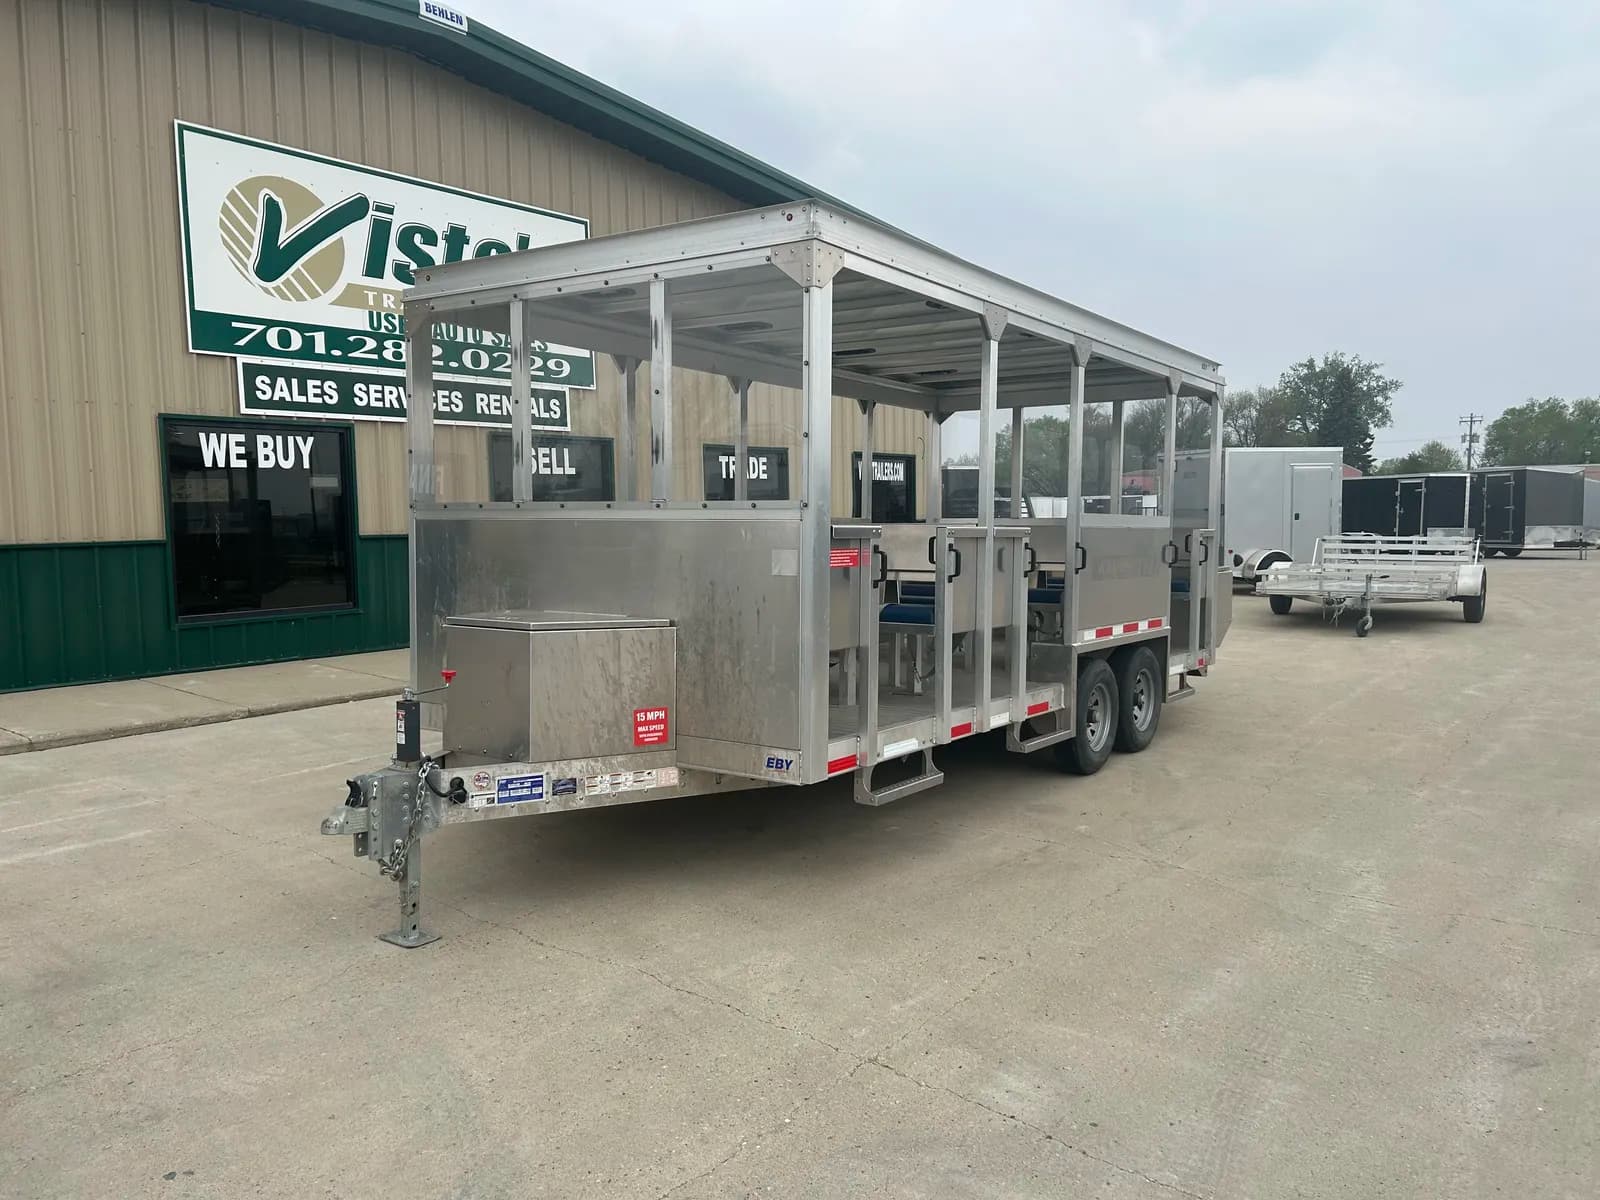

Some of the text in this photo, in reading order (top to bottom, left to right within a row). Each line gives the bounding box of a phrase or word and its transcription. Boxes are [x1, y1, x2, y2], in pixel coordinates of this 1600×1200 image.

[425, 2, 463, 25] BEHLEN
[255, 375, 561, 419] SALES SERVES RENALS
[198, 432, 315, 470] WE BUY
[718, 455, 768, 480] TRDE
[636, 710, 665, 722] 15 MPH
[765, 756, 794, 770] EBY
